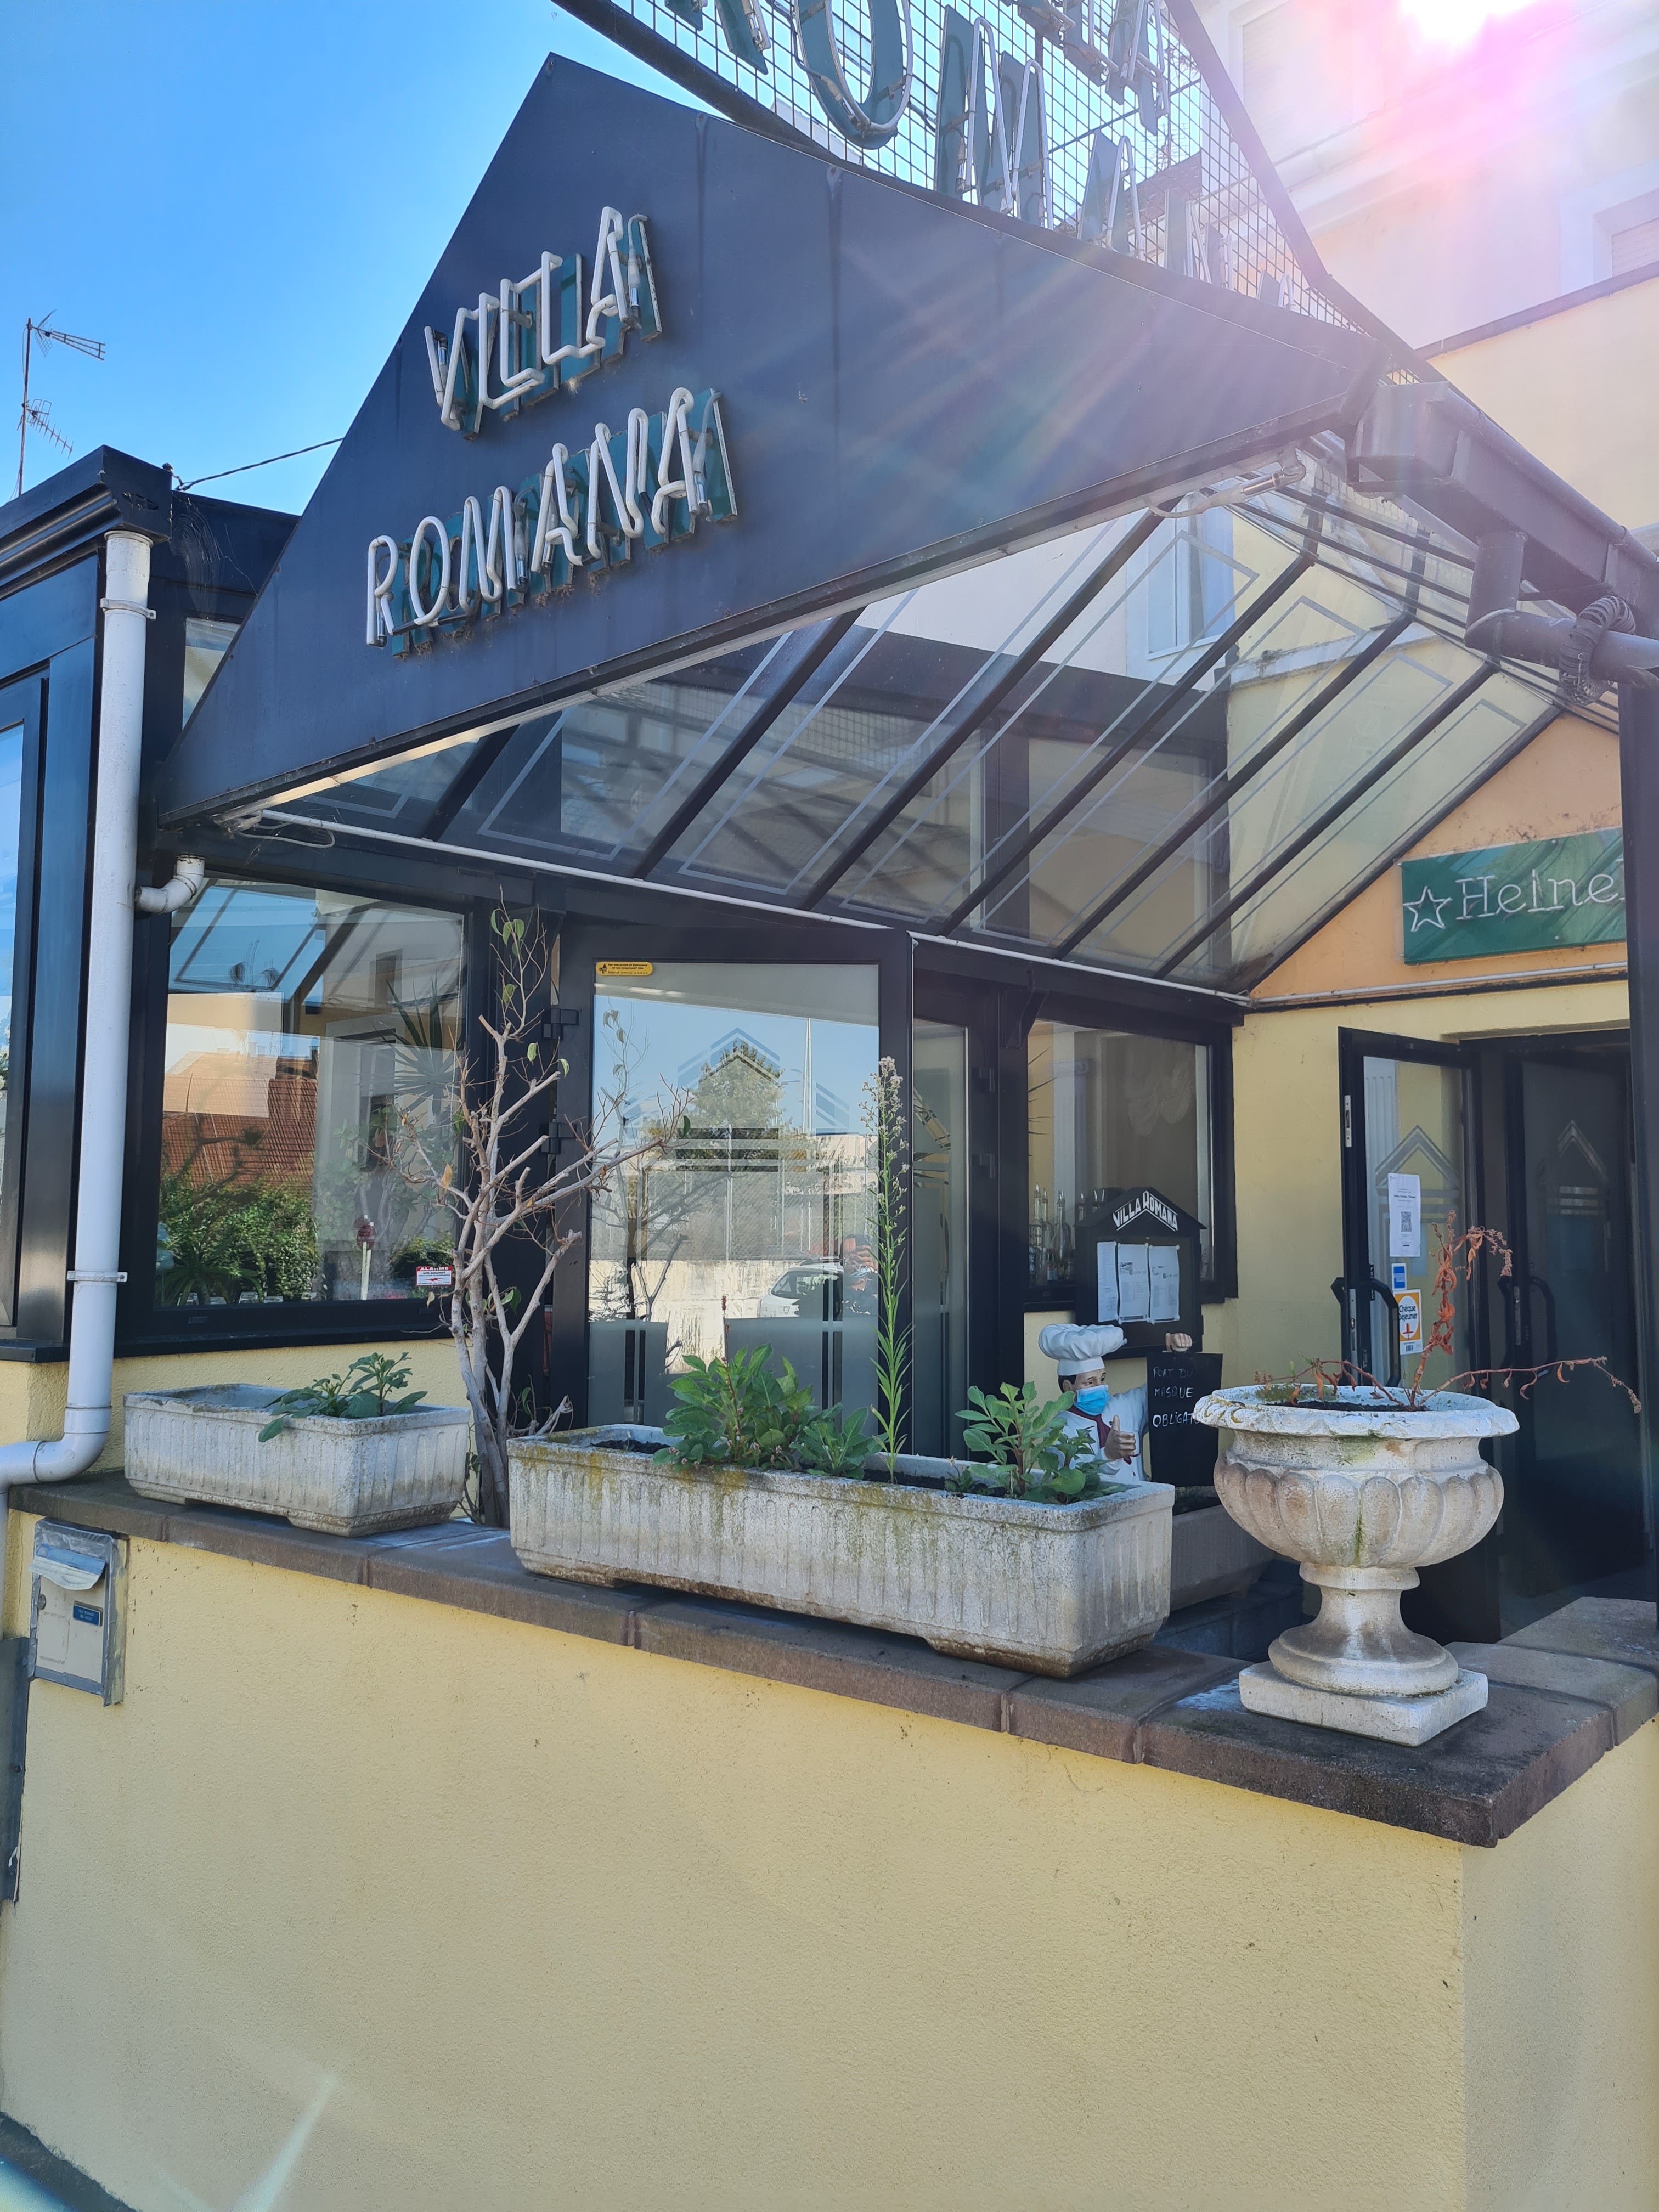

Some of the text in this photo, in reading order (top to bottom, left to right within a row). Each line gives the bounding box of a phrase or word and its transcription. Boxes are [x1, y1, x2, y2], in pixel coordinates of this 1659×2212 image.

[424, 206, 662, 438] VILLA
[366, 387, 738, 658] ROMANA
[1455, 858, 1626, 921] Heine
[1113, 1190, 1178, 1232] VILLA ROMANA
[1153, 1366, 1194, 1378] PORT DU
[1154, 1386, 1194, 1398] MASQUE
